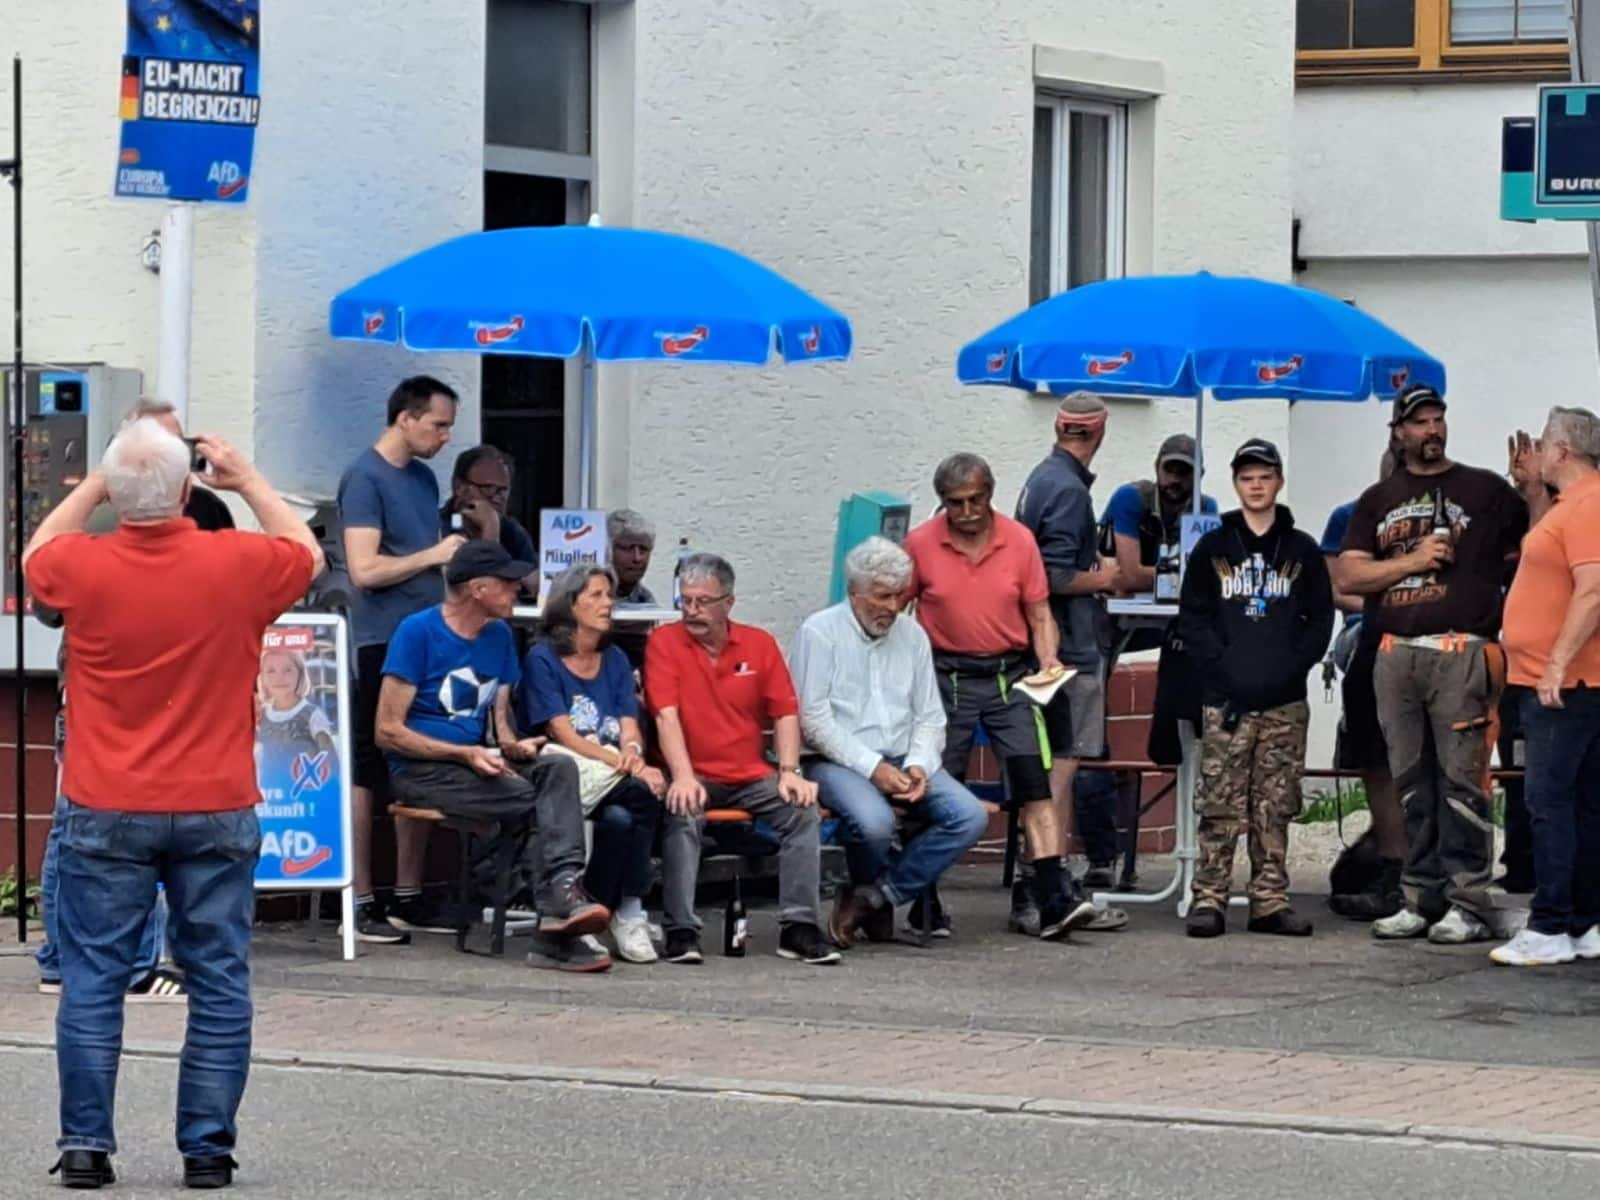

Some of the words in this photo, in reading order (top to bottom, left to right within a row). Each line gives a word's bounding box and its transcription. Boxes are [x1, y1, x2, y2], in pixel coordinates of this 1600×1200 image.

[144, 59, 243, 92] EU-MACHT
[142, 91, 258, 124] BEGRENZEN!
[207, 160, 240, 184] AfD
[551, 514, 584, 530] AfD
[260, 829, 317, 858] AfD
